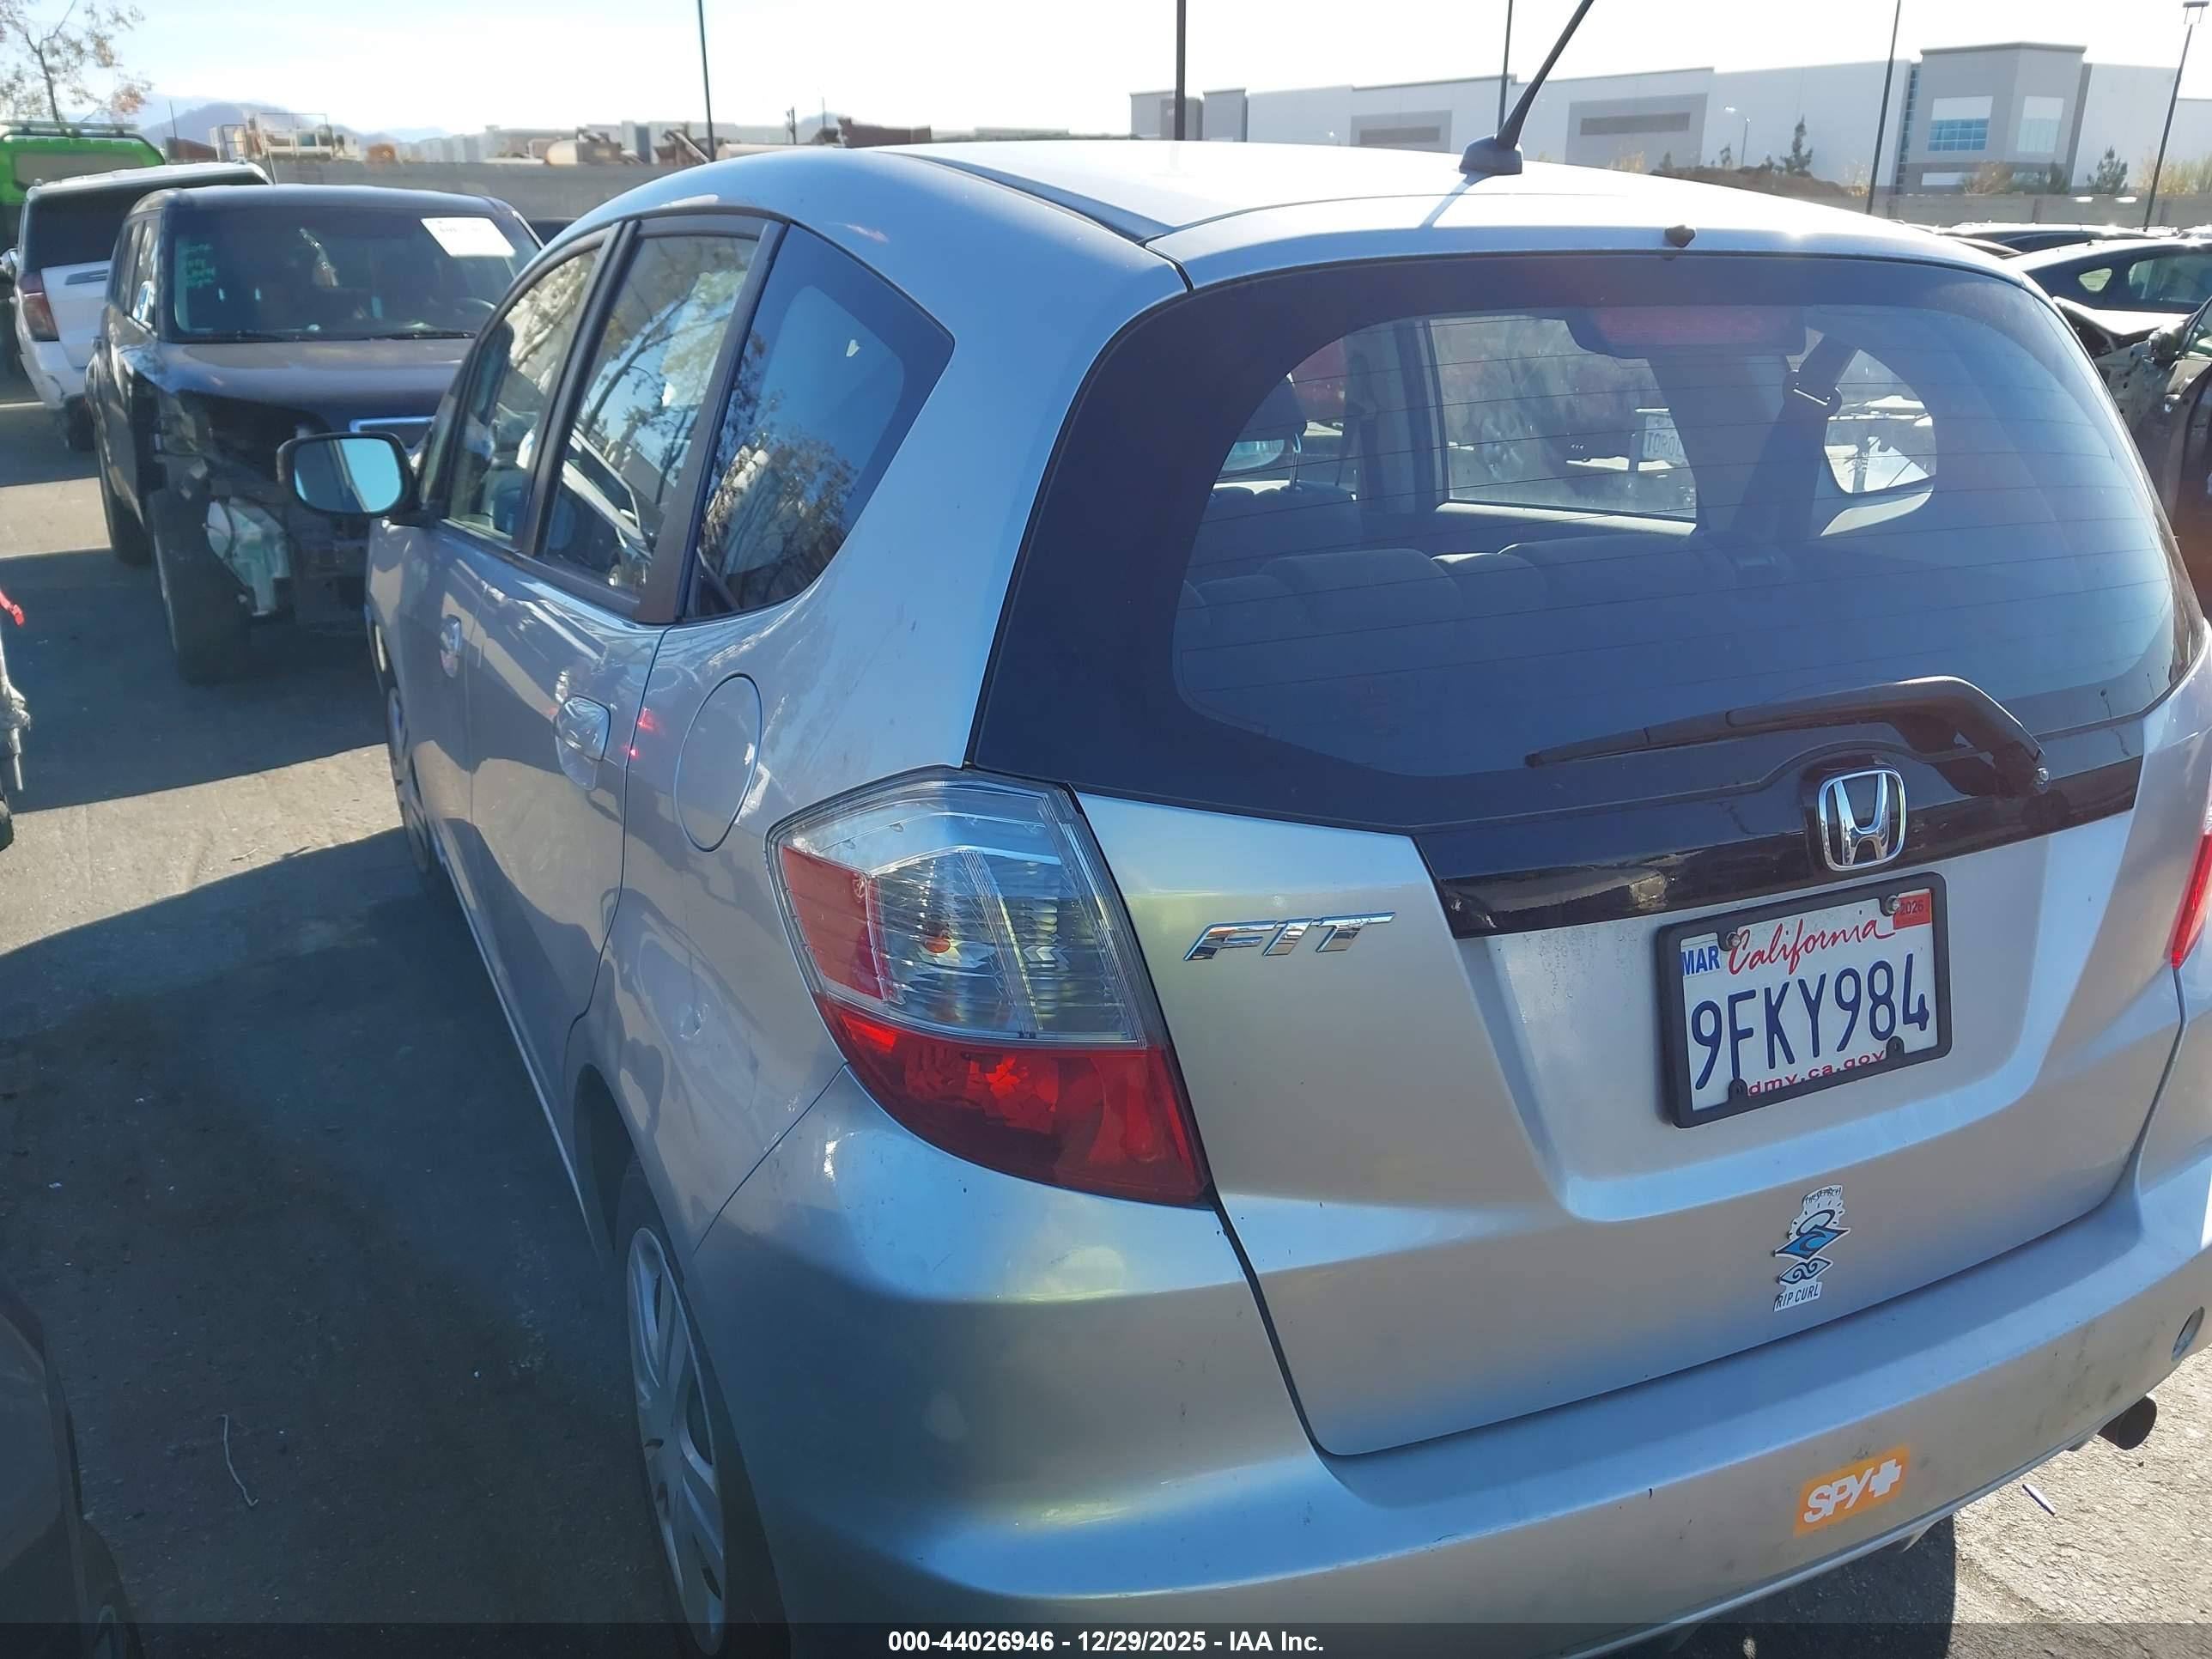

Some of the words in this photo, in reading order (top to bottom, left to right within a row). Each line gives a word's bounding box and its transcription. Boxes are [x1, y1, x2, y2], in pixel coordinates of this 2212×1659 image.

[1182, 912, 1396, 961] FIT
[1681, 945, 1721, 976] MAR
[1727, 918, 1896, 975] California
[1691, 952, 1930, 1091] 9FKY984
[1748, 1049, 1886, 1097] dmv.ca.gov
[1776, 1292, 1794, 1310] RIP
[1795, 1284, 1820, 1303] CURL
